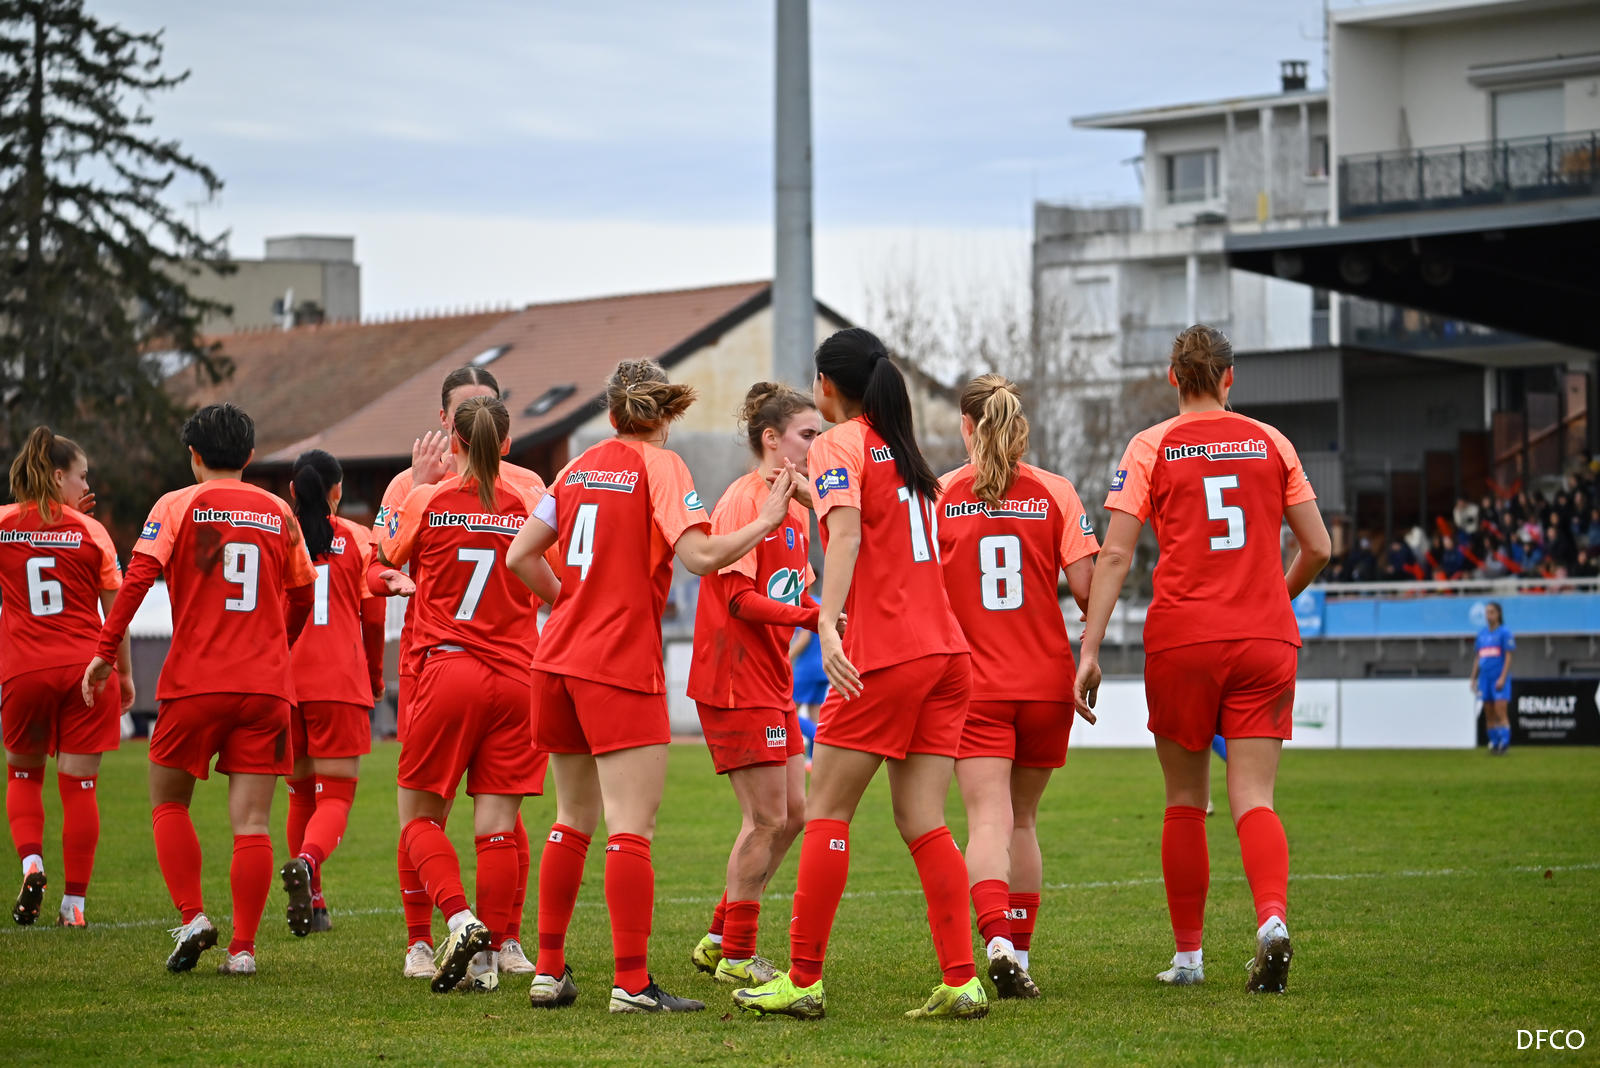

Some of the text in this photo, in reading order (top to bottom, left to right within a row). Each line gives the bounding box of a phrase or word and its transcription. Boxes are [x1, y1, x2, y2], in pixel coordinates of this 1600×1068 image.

[1165, 440, 1267, 460] Intermarché
[565, 470, 638, 490] Intermarché
[194, 509, 280, 531] Intermarché
[430, 512, 525, 532] Intermarché
[897, 485, 941, 565] 1
[1203, 474, 1246, 551] 5
[0, 530, 82, 547] Intermarché
[566, 503, 599, 581] 4
[26, 556, 64, 616] 6
[222, 542, 260, 612] 9
[454, 547, 496, 620] 7
[979, 534, 1024, 611] 8
[1518, 696, 1577, 713] RENAULT
[766, 726, 786, 739] Inte
